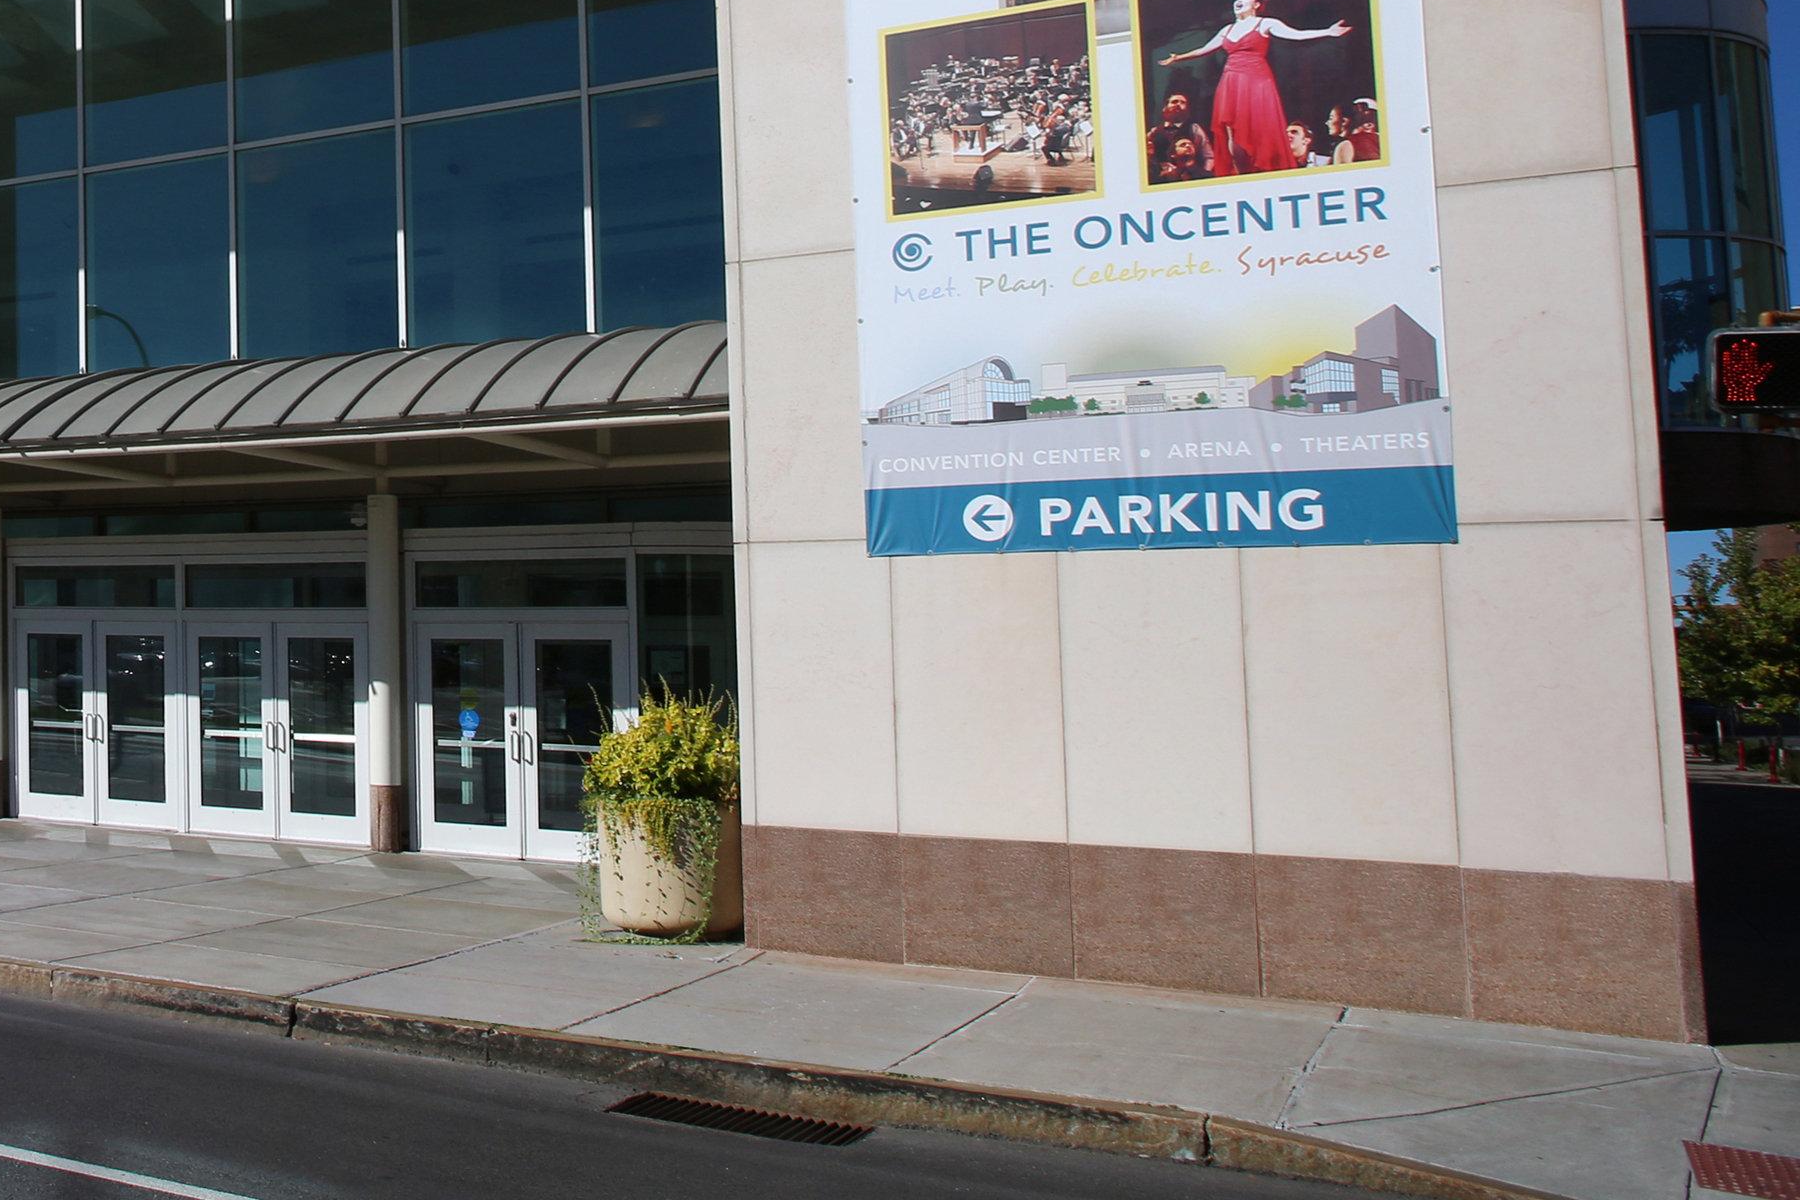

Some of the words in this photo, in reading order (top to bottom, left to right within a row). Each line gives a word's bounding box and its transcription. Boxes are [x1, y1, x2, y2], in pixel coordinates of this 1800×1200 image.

[955, 221, 1051, 262] THE
[1074, 186, 1388, 250] ONCENTER
[893, 277, 961, 304] Meet.
[976, 274, 1054, 297] Play.
[1071, 253, 1222, 288] Celebrate.
[1236, 243, 1391, 276] Syracuse
[879, 450, 1024, 474] CONVENTION
[1032, 446, 1121, 467] CENTER
[1167, 440, 1252, 459] ARENA
[1300, 431, 1431, 453] THEATERS
[1039, 488, 1325, 537] PARKING
